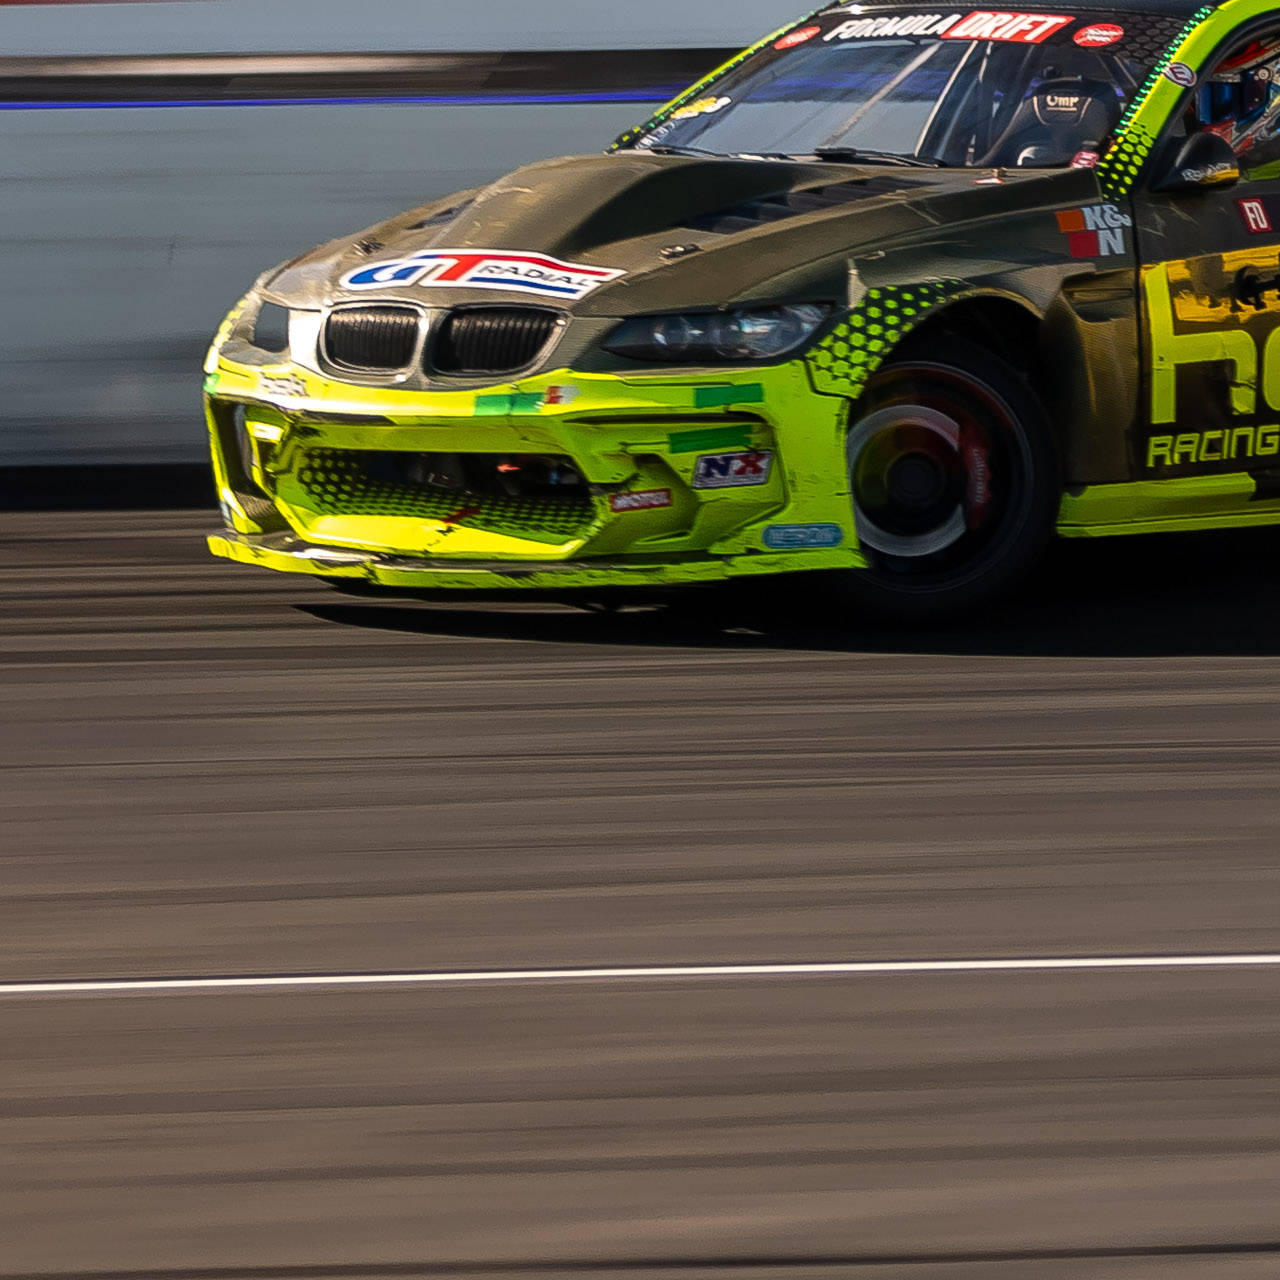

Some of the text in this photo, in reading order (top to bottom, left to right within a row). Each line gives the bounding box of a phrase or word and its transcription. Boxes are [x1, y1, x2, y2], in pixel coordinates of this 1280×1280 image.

[822, 13, 962, 42] FORMULA
[949, 11, 1066, 41] DRIFT
[1243, 202, 1268, 231] FD
[478, 264, 595, 287] RADIAL
[1147, 425, 1280, 467] RACING
[702, 454, 768, 478] NX
